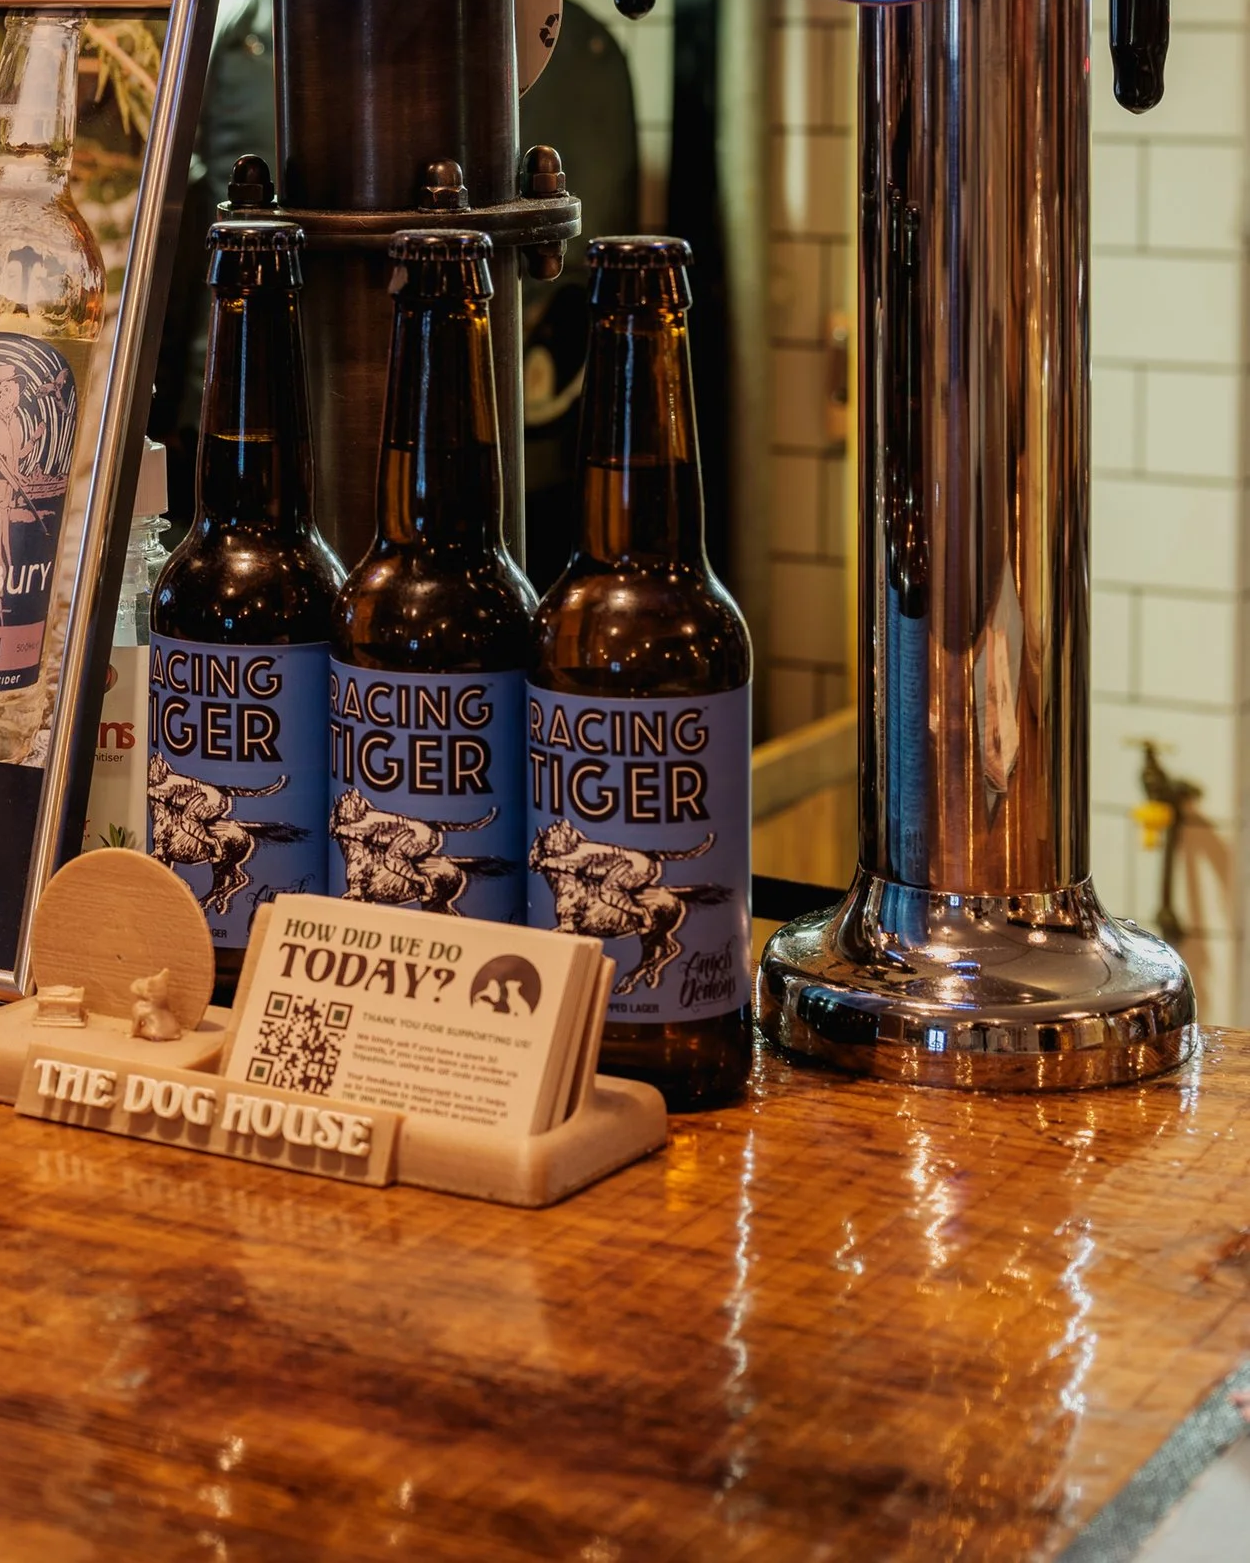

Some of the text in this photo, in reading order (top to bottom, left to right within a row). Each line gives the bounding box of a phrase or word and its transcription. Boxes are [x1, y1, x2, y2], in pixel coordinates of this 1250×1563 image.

[150, 644, 283, 700] ACING
[330, 670, 493, 730] RACING
[149, 690, 283, 763] IGER
[330, 719, 494, 795] TIGER
[529, 696, 709, 757] RACING
[529, 746, 711, 824] TIGER
[284, 918, 462, 963] HOW DID WE DO
[279, 942, 456, 1003] TODAY?
[400, 1018, 420, 1029] YOU
[422, 1022, 443, 1033] FOR
[34, 1058, 374, 1157] THE DOG HOUSE
